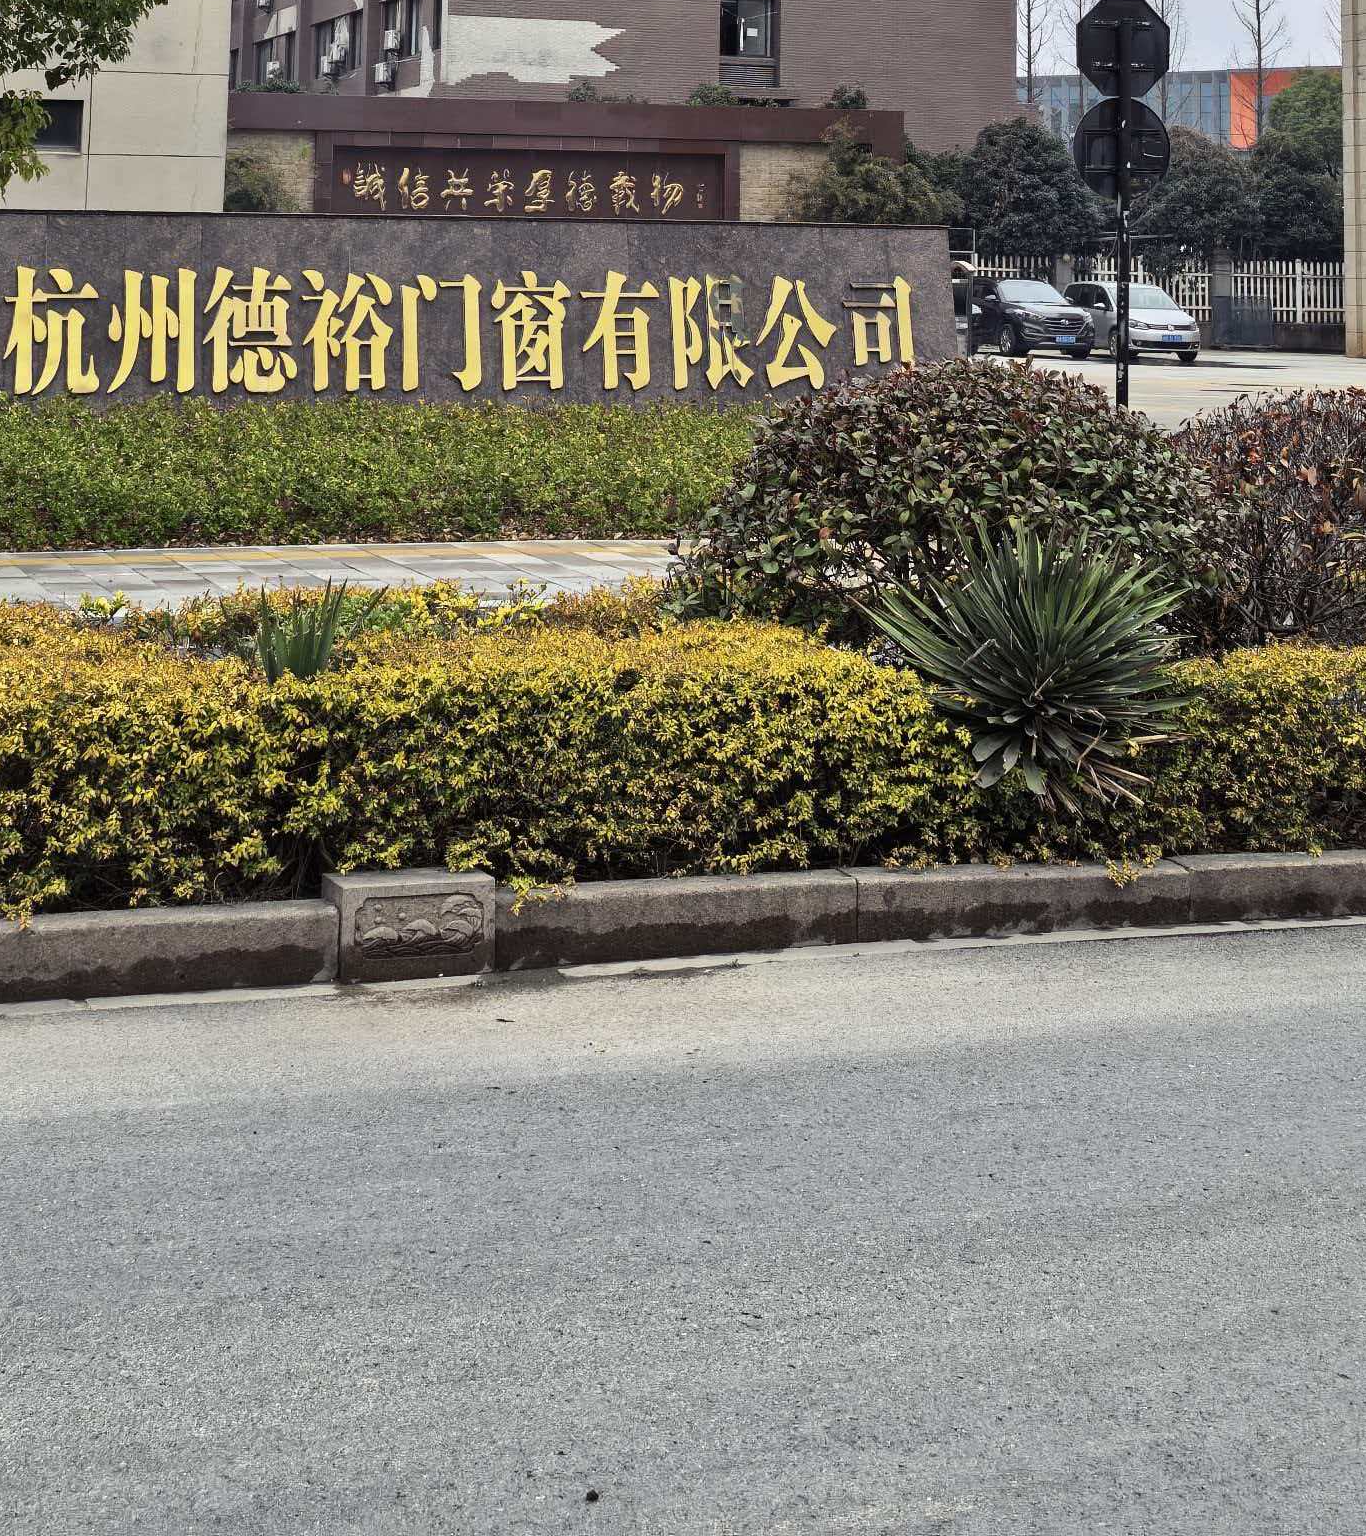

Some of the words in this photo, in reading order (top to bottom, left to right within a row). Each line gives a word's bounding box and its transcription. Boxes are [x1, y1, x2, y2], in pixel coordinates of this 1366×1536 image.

[3, 265, 915, 394] 杭州德裕门窗有限公司
